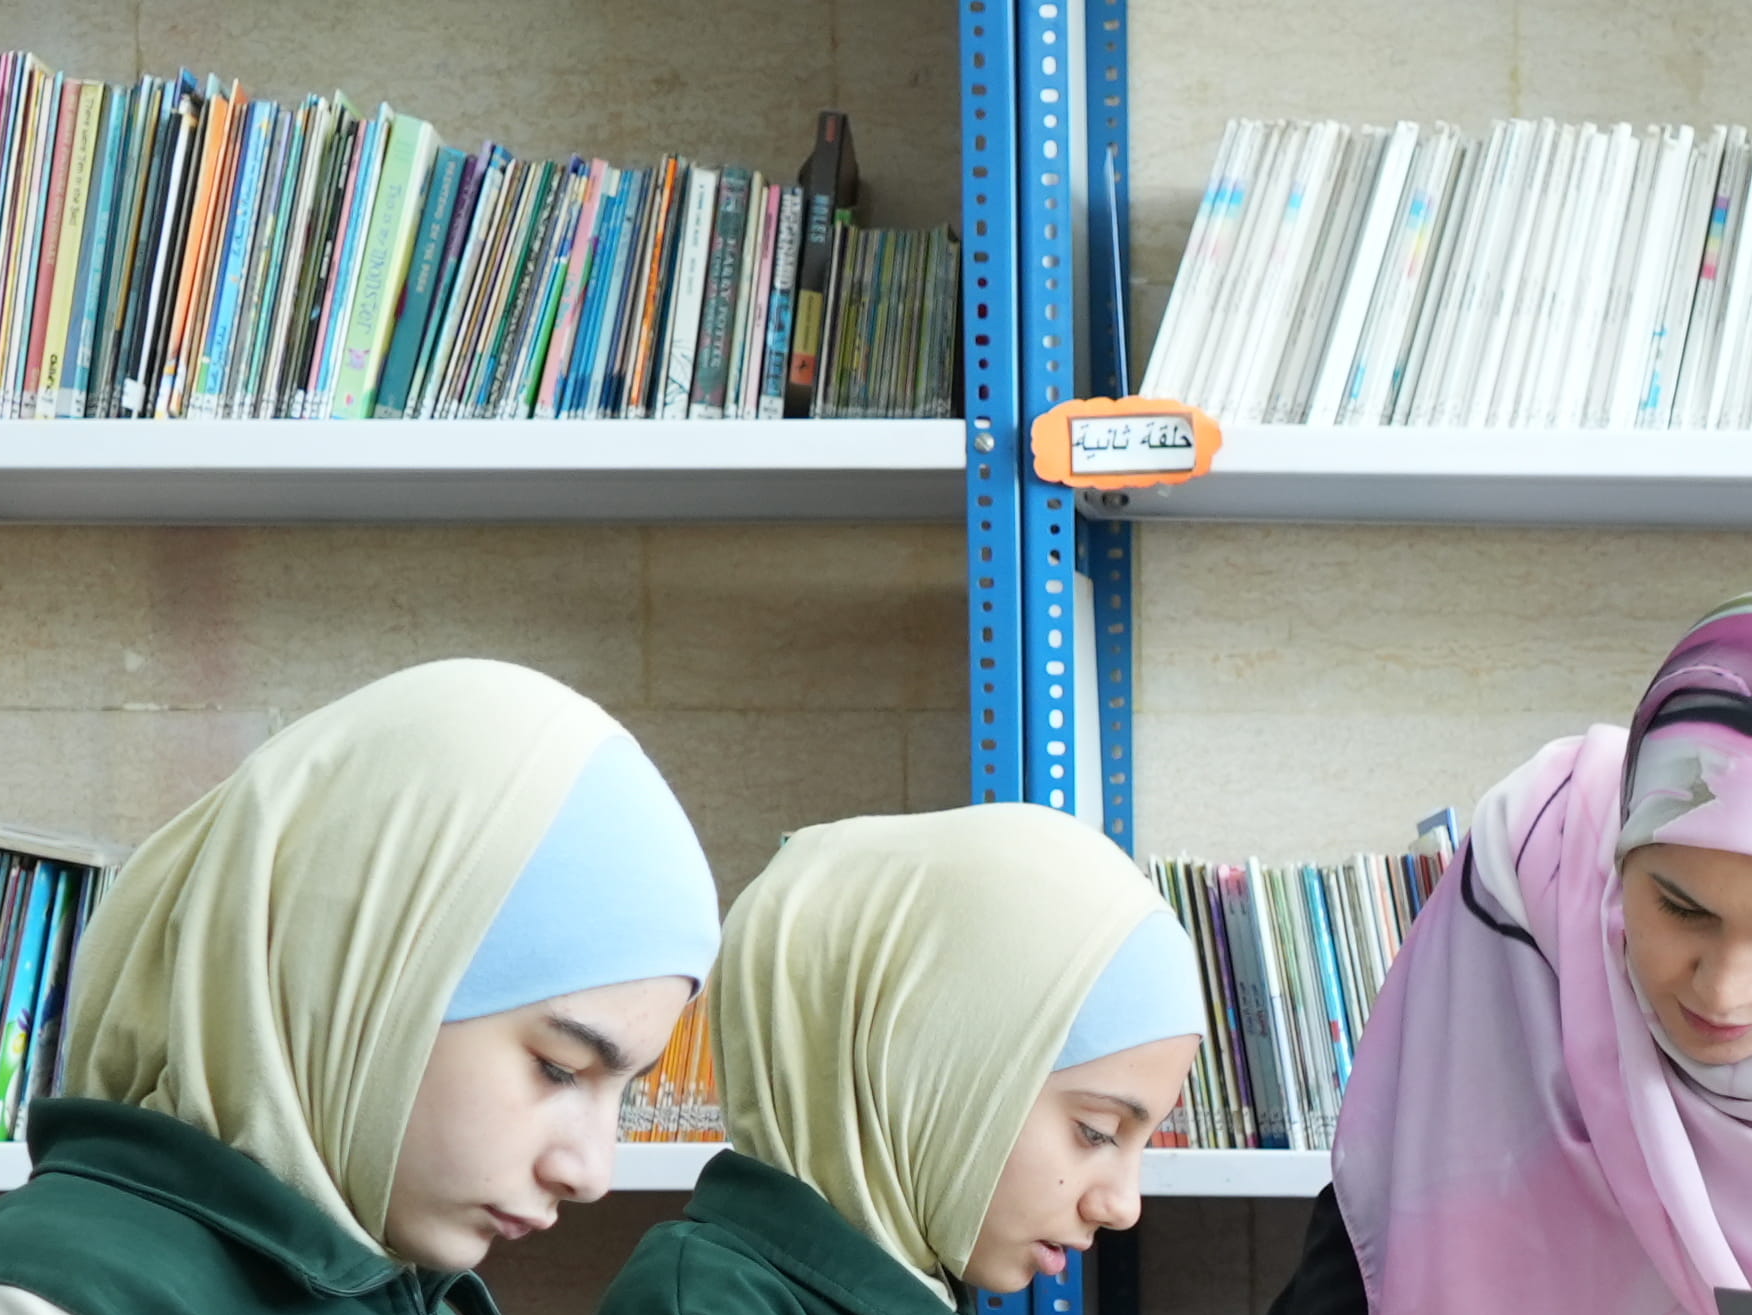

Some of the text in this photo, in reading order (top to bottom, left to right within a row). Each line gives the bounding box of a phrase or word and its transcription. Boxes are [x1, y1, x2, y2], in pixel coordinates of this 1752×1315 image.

[811, 193, 831, 242] HOLES
[721, 236, 741, 302] HARRY
[711, 305, 732, 370] POTTER
[1072, 421, 1194, 460] حلقة ثانية
